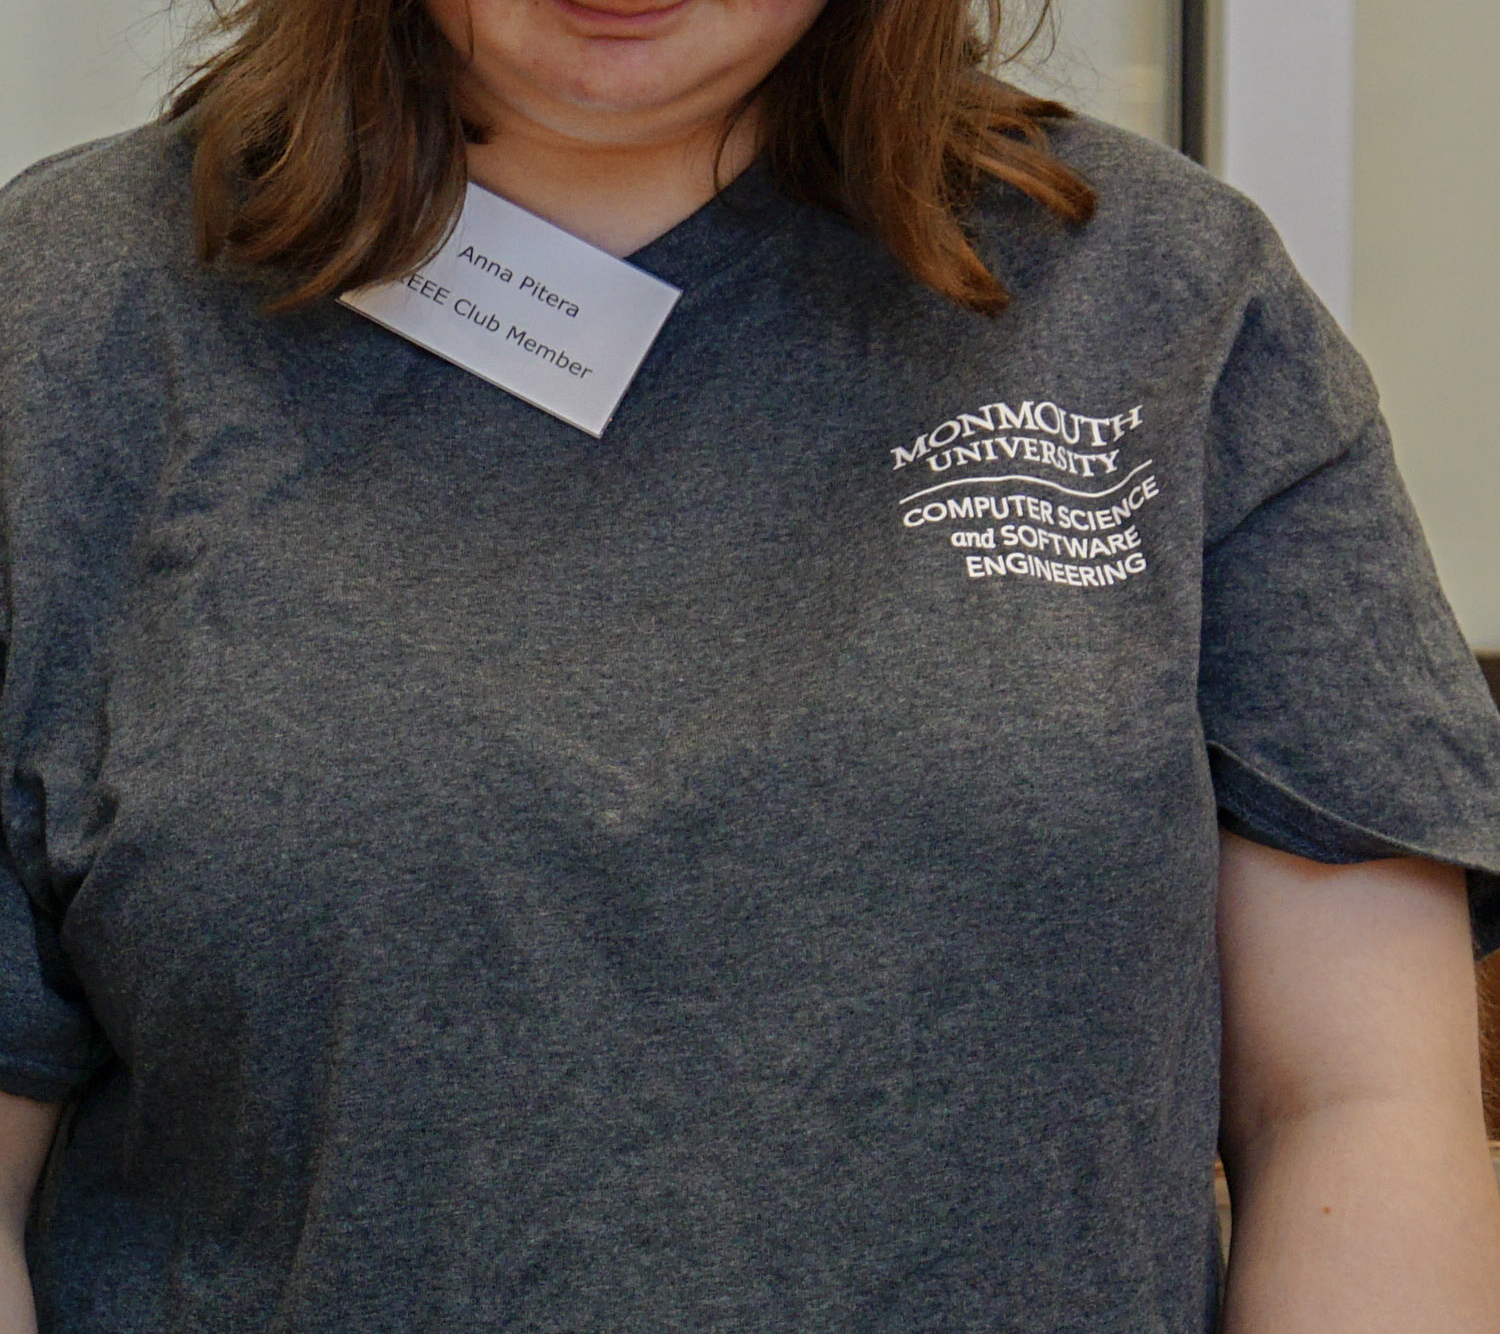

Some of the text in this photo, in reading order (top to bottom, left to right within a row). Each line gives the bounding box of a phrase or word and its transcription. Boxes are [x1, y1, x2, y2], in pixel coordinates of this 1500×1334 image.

[458, 245, 580, 318] Anna Pitera
[453, 298, 501, 332] Club
[505, 326, 592, 379] Member
[890, 401, 1143, 470] MONMOUTH
[926, 437, 1119, 477] UNIVERSITY
[903, 476, 1160, 531] COMPUTER SCIENCE
[951, 525, 1141, 558] and SOFTWARE
[966, 552, 1147, 587] ENGINEERING
